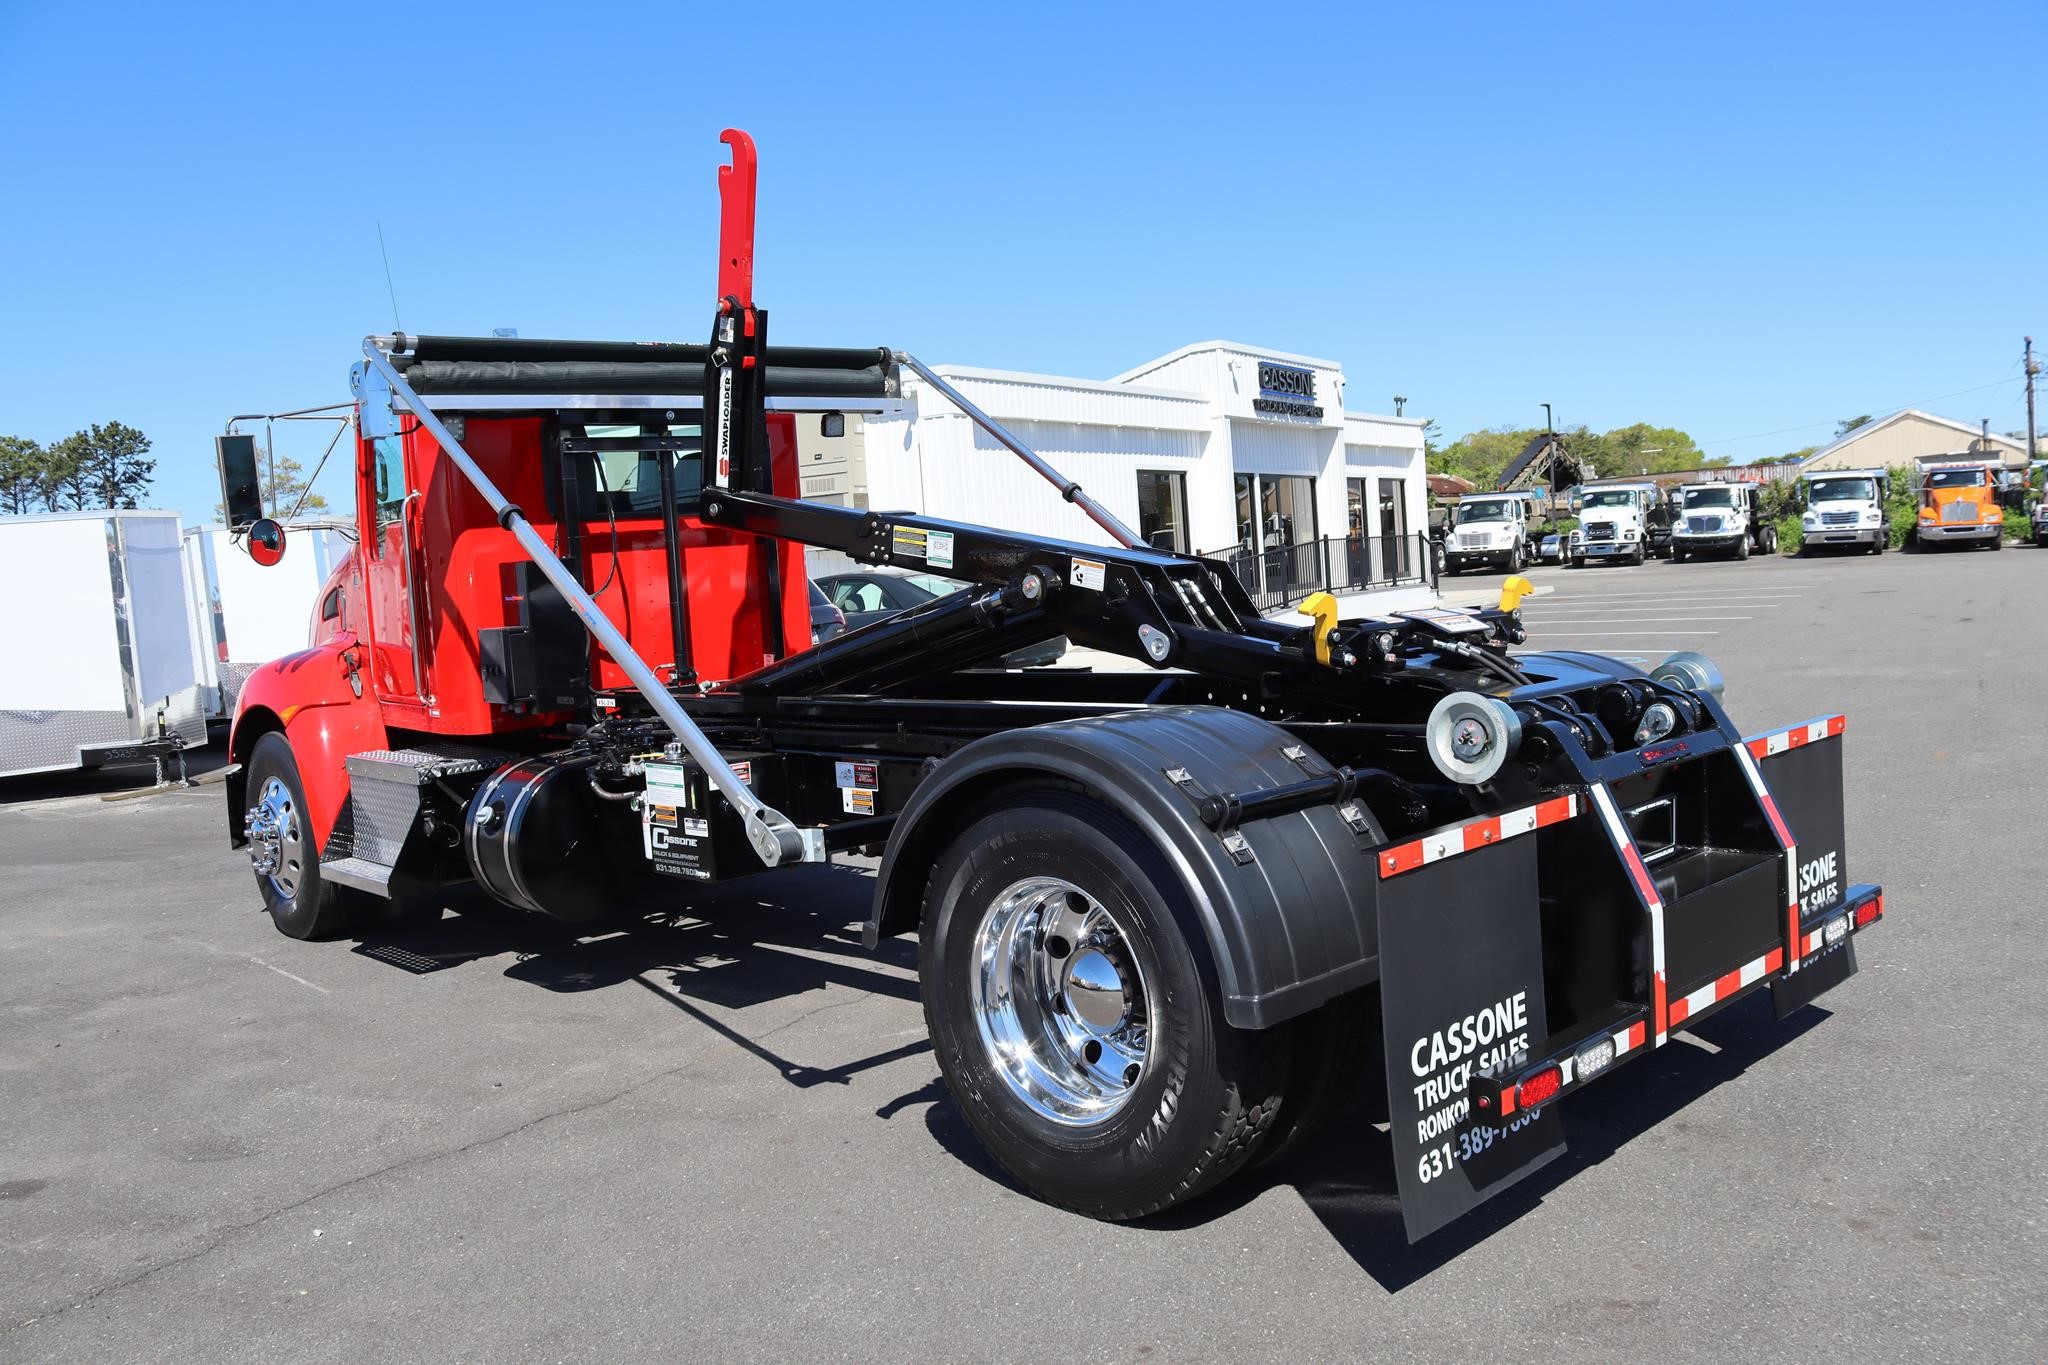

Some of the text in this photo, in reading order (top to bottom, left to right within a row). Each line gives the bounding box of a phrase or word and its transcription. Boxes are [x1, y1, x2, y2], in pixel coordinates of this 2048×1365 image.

[1259, 366, 1316, 396] CASSONE
[722, 377, 731, 456] SWAPLOADER
[672, 852, 699, 861] EQUIPMENT
[1411, 991, 1528, 1077] CASSONE
[1413, 1060, 1473, 1112] TRUCK
